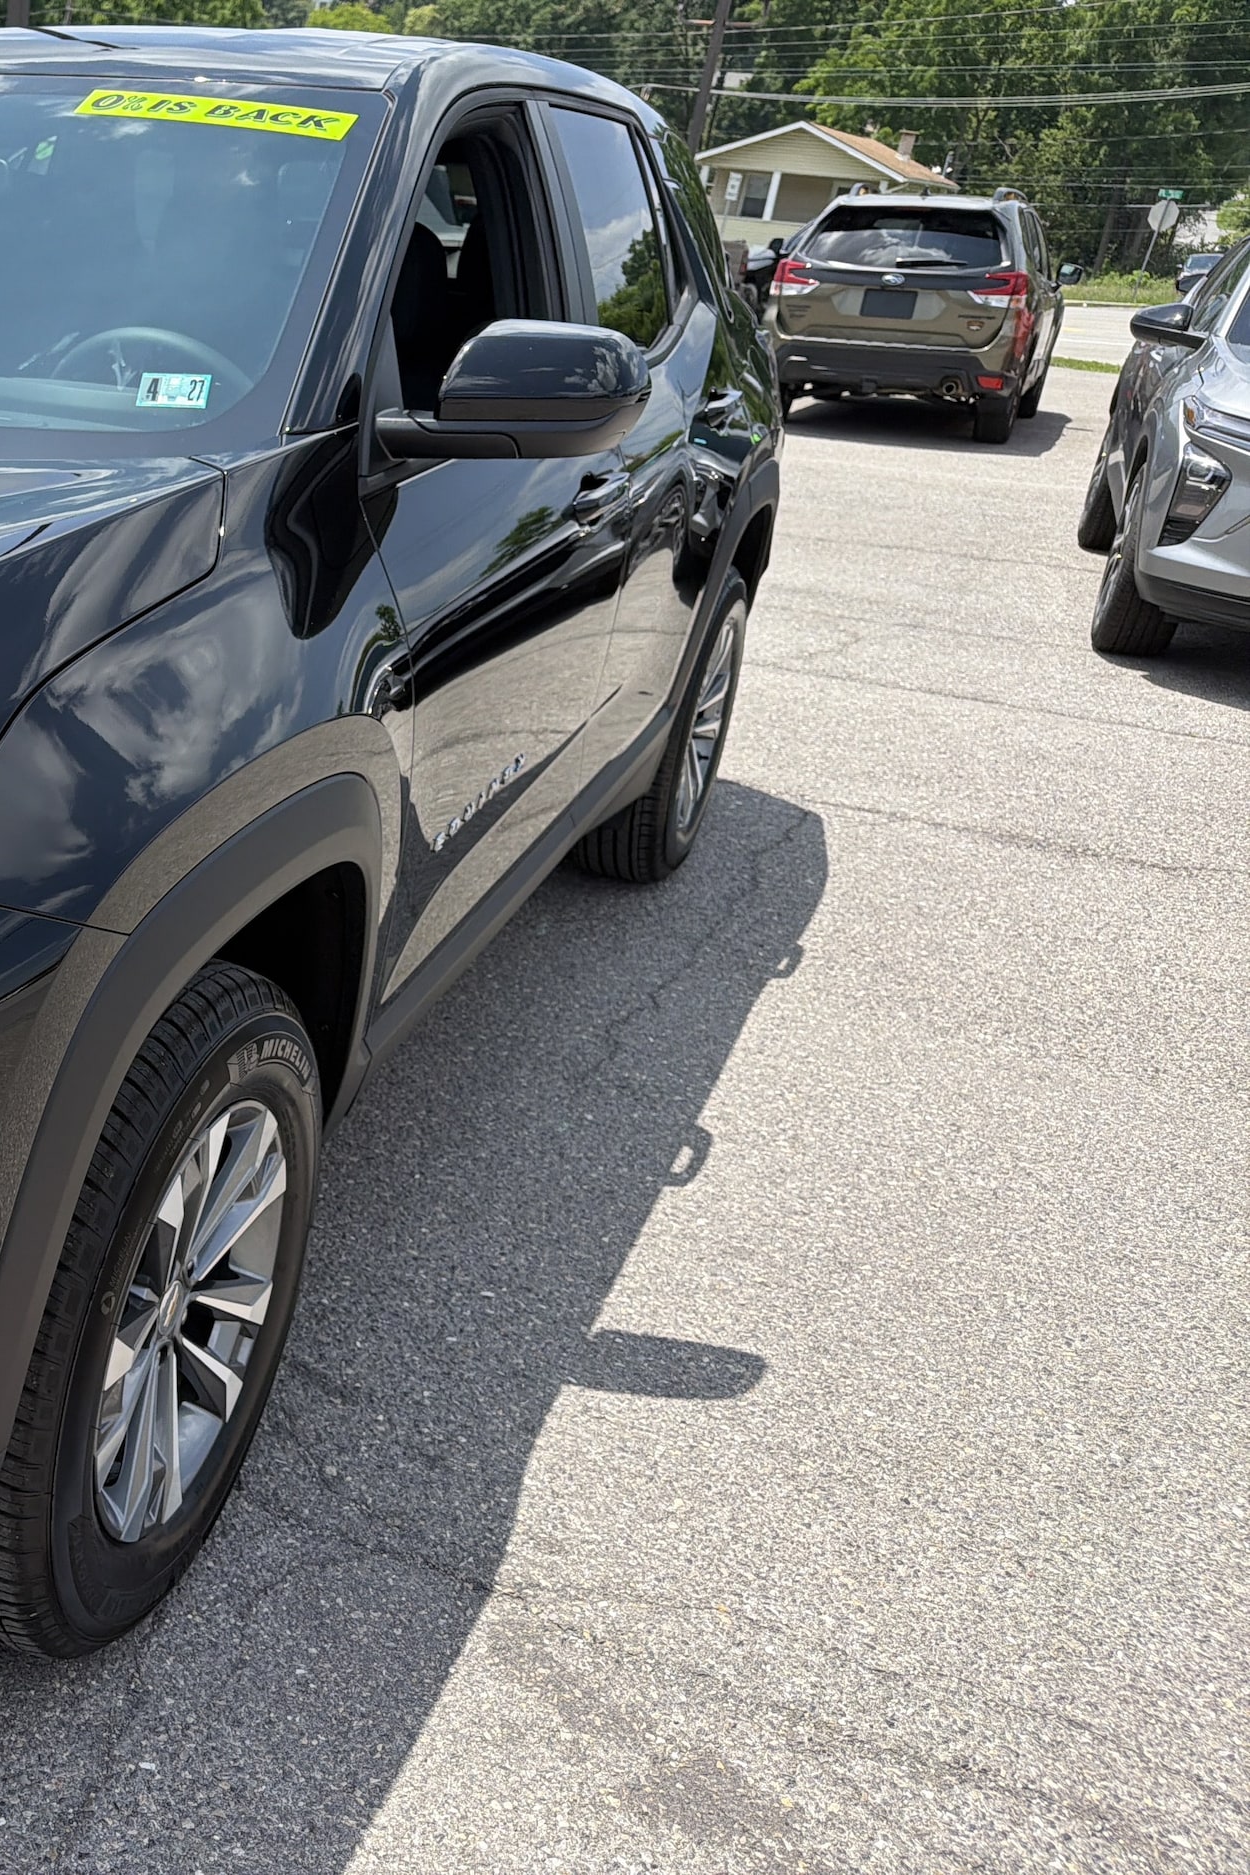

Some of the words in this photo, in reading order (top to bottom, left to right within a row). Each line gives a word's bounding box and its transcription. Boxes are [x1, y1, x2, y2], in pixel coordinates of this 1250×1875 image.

[91, 94, 148, 111] 0%
[147, 99, 197, 114] IS
[204, 104, 340, 132] BACK
[146, 377, 160, 402] 4
[187, 379, 205, 402] 27
[260, 1038, 311, 1081] MICHELIN
